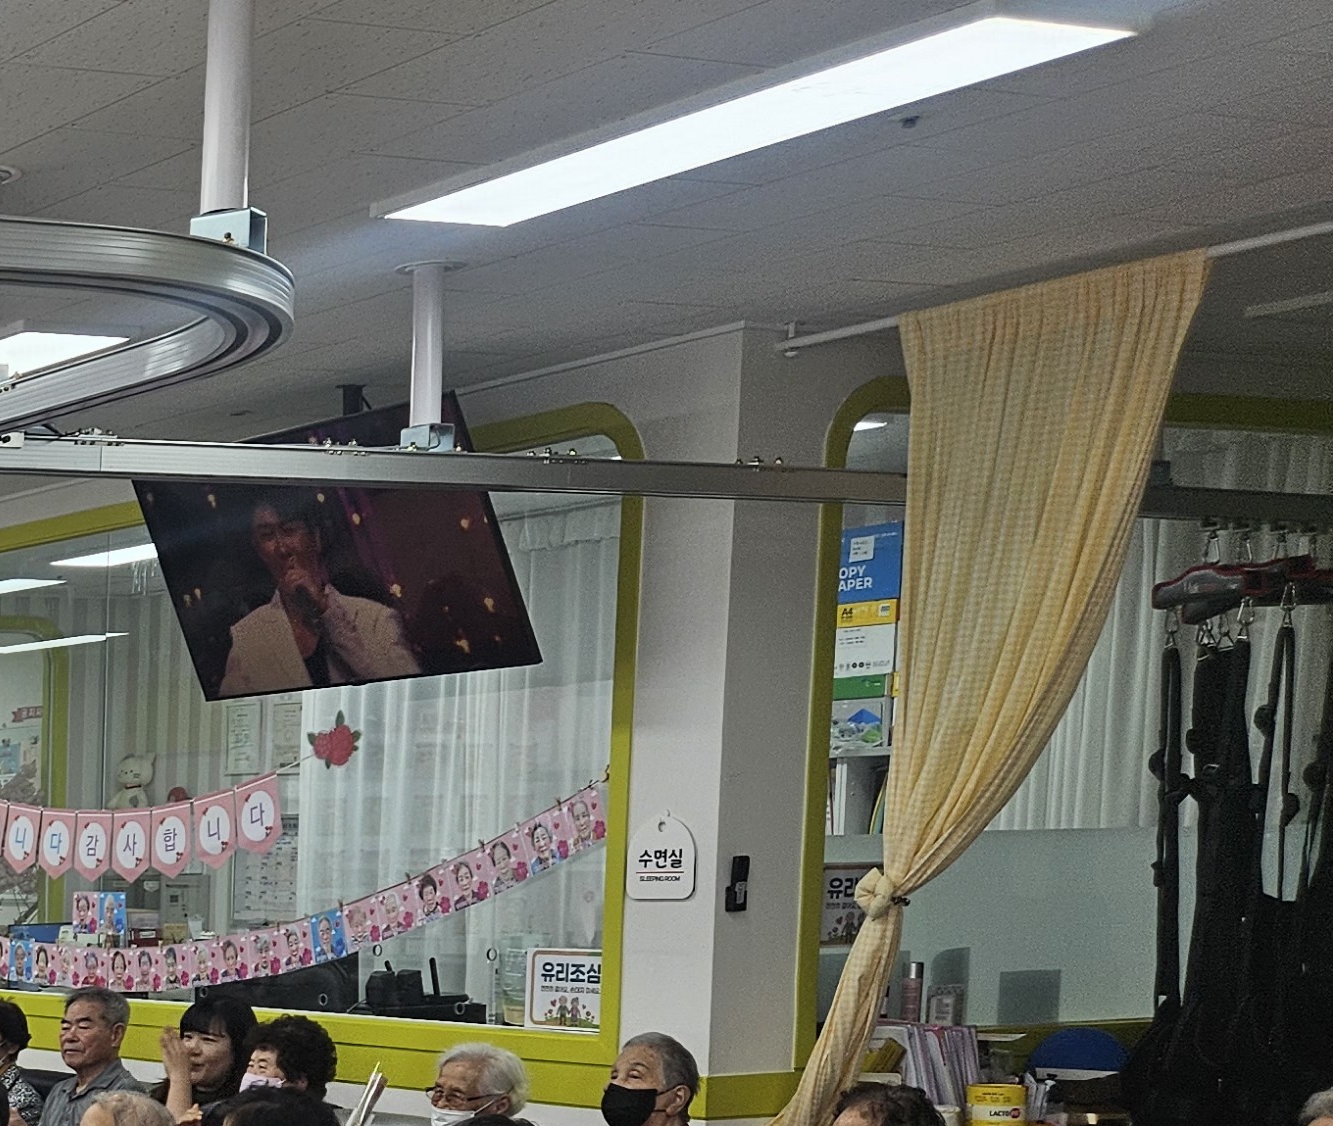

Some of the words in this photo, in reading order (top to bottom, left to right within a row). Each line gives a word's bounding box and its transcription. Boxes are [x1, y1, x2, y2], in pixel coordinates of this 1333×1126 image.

[839, 565, 866, 579] OPY
[838, 577, 873, 592] APER
[842, 607, 853, 616] A4
[85, 802, 265, 857] 감사합니다
[639, 848, 683, 869] 수면실
[541, 962, 602, 984] 유리조심
